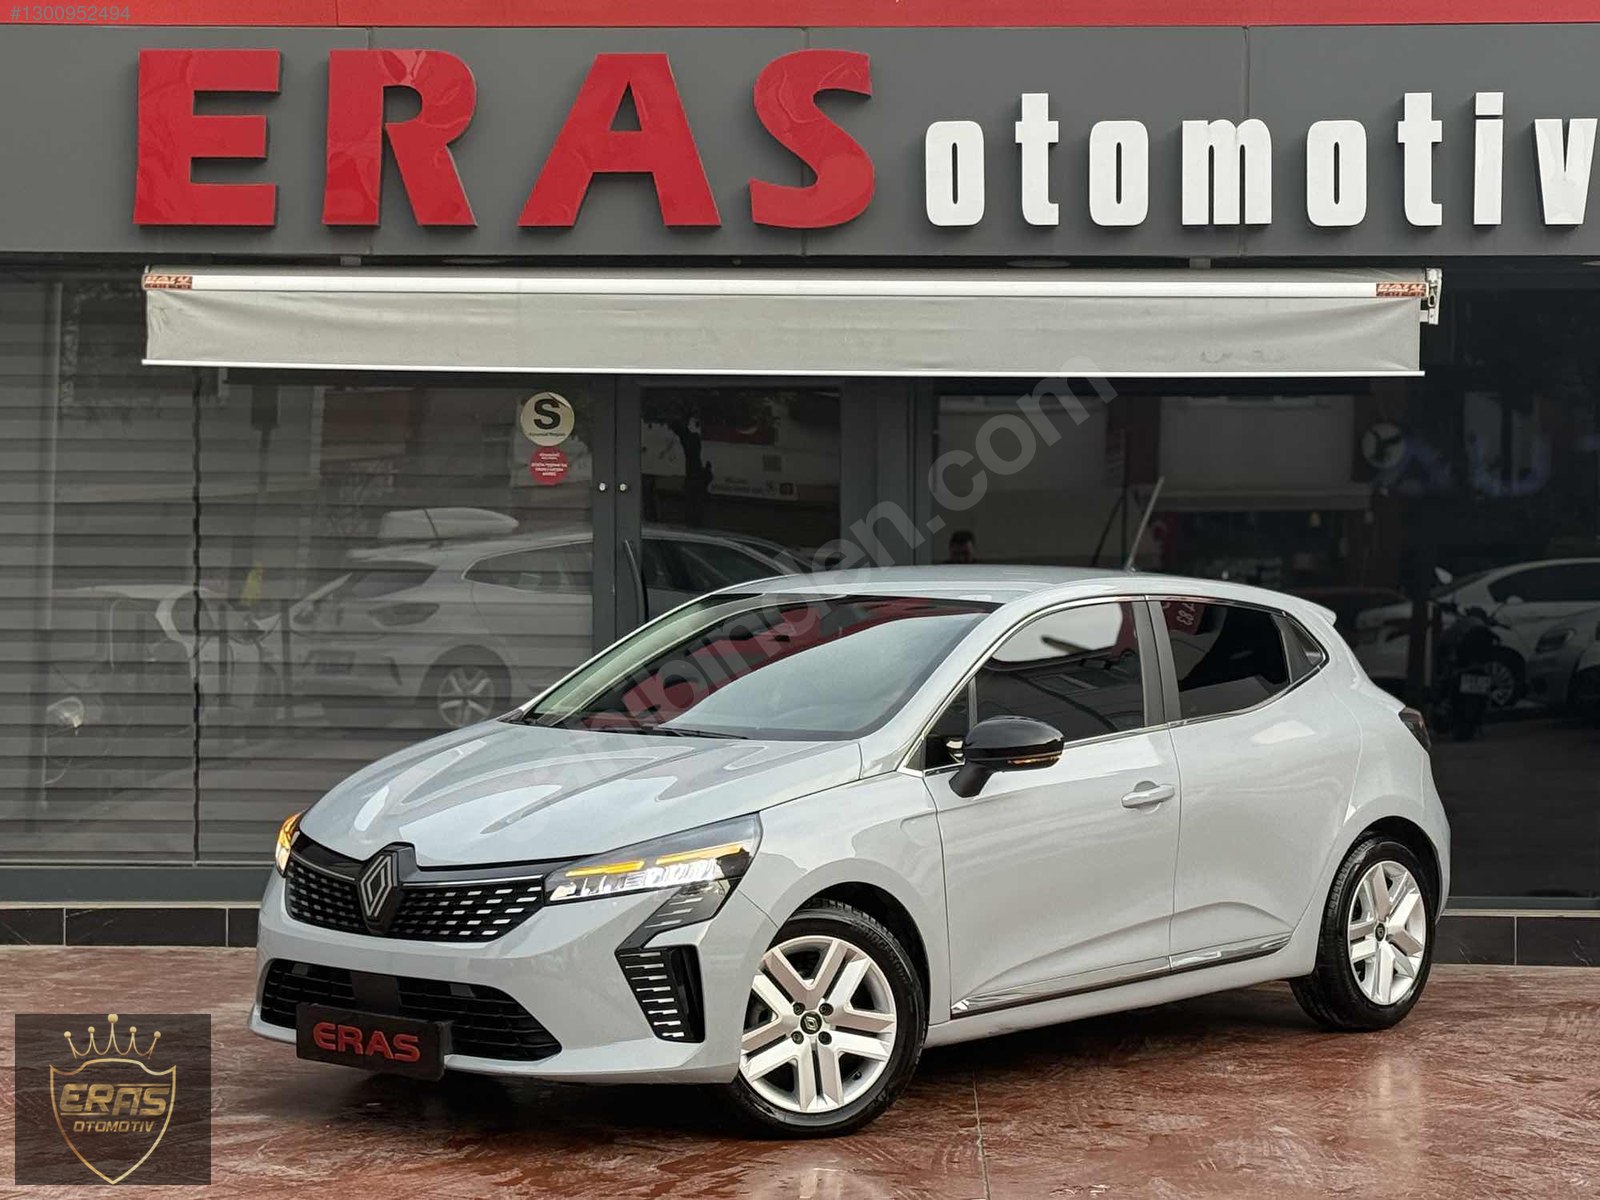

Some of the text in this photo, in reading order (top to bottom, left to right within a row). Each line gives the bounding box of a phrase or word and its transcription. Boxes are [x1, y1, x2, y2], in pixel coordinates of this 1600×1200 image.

[133, 48, 1598, 229] ERAS otomotiv
[533, 399, 561, 430] S
[313, 1021, 421, 1062] ERAS
